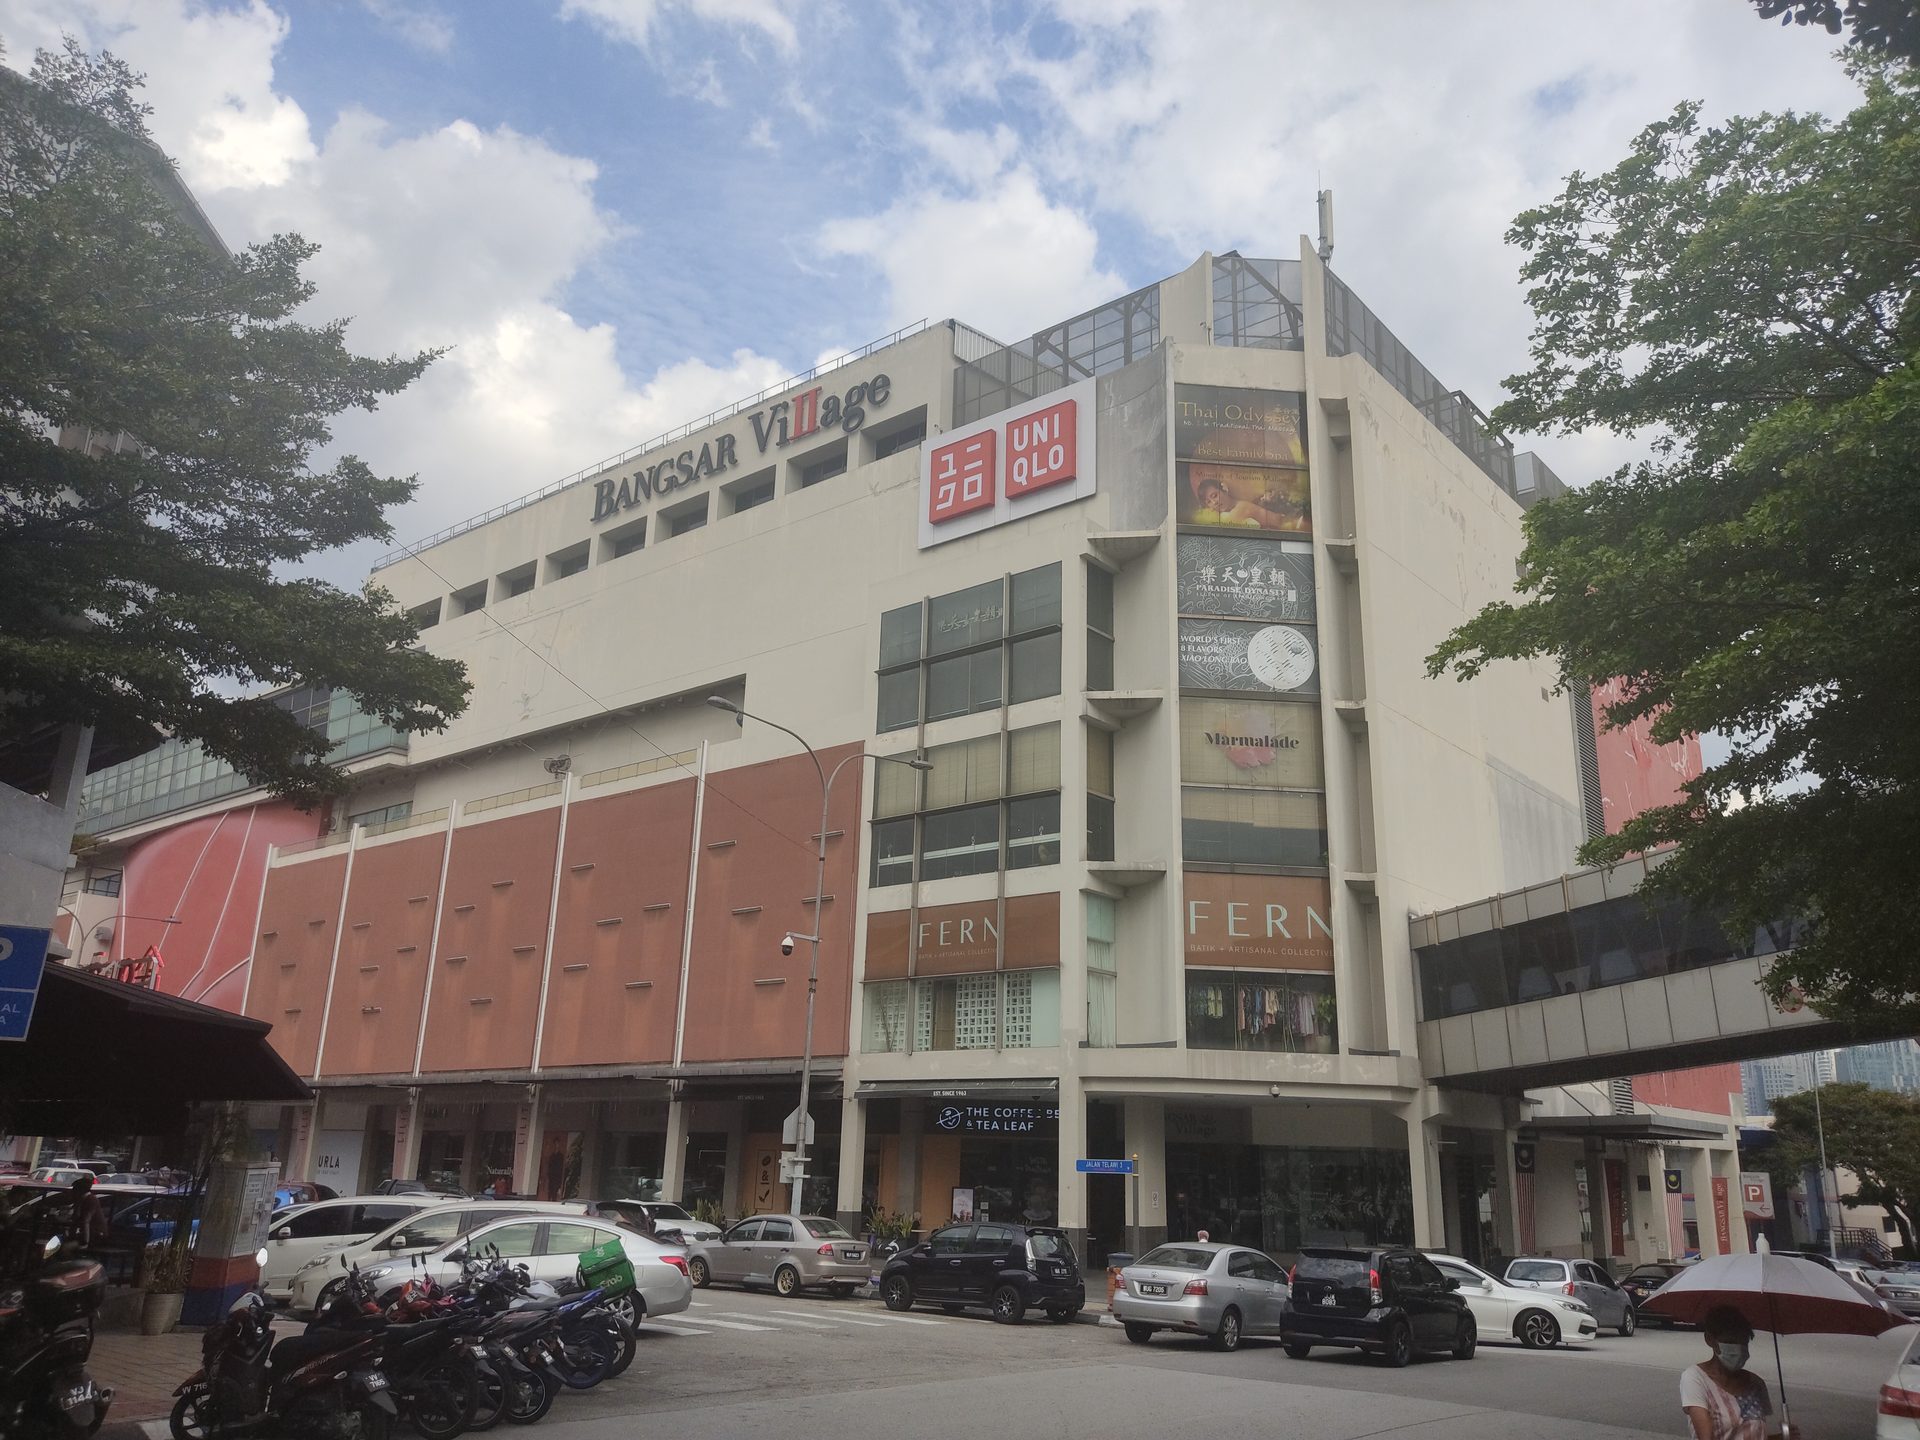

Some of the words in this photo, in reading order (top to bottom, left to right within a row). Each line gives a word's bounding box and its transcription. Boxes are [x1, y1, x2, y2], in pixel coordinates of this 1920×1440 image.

[1178, 400, 1219, 419] Thai
[1224, 404, 1300, 425] Odyssey
[1012, 411, 1061, 453] UNI
[1198, 444, 1223, 457] Best
[1011, 444, 1065, 487] QLO
[590, 433, 738, 523] BANGSAR
[1196, 584, 1241, 593] PARADISE
[1244, 587, 1285, 596] DYNASTY
[1180, 635, 1218, 644] WORLD'S
[1188, 645, 1223, 654] FLAVORS
[1181, 654, 1202, 662] XIAO
[1204, 732, 1300, 749] Marmalade
[1189, 900, 1333, 940] FERN
[919, 917, 999, 948] FERN
[1190, 944, 1216, 952] BATIK
[1228, 946, 1278, 955] ARTISANAL
[966, 1107, 989, 1117] THE
[966, 1120, 973, 1129] &
[976, 1121, 1000, 1130] TEA
[1004, 1121, 1034, 1131] LEAF
[318, 1155, 340, 1169] URLA
[1748, 1186, 1761, 1201] P
